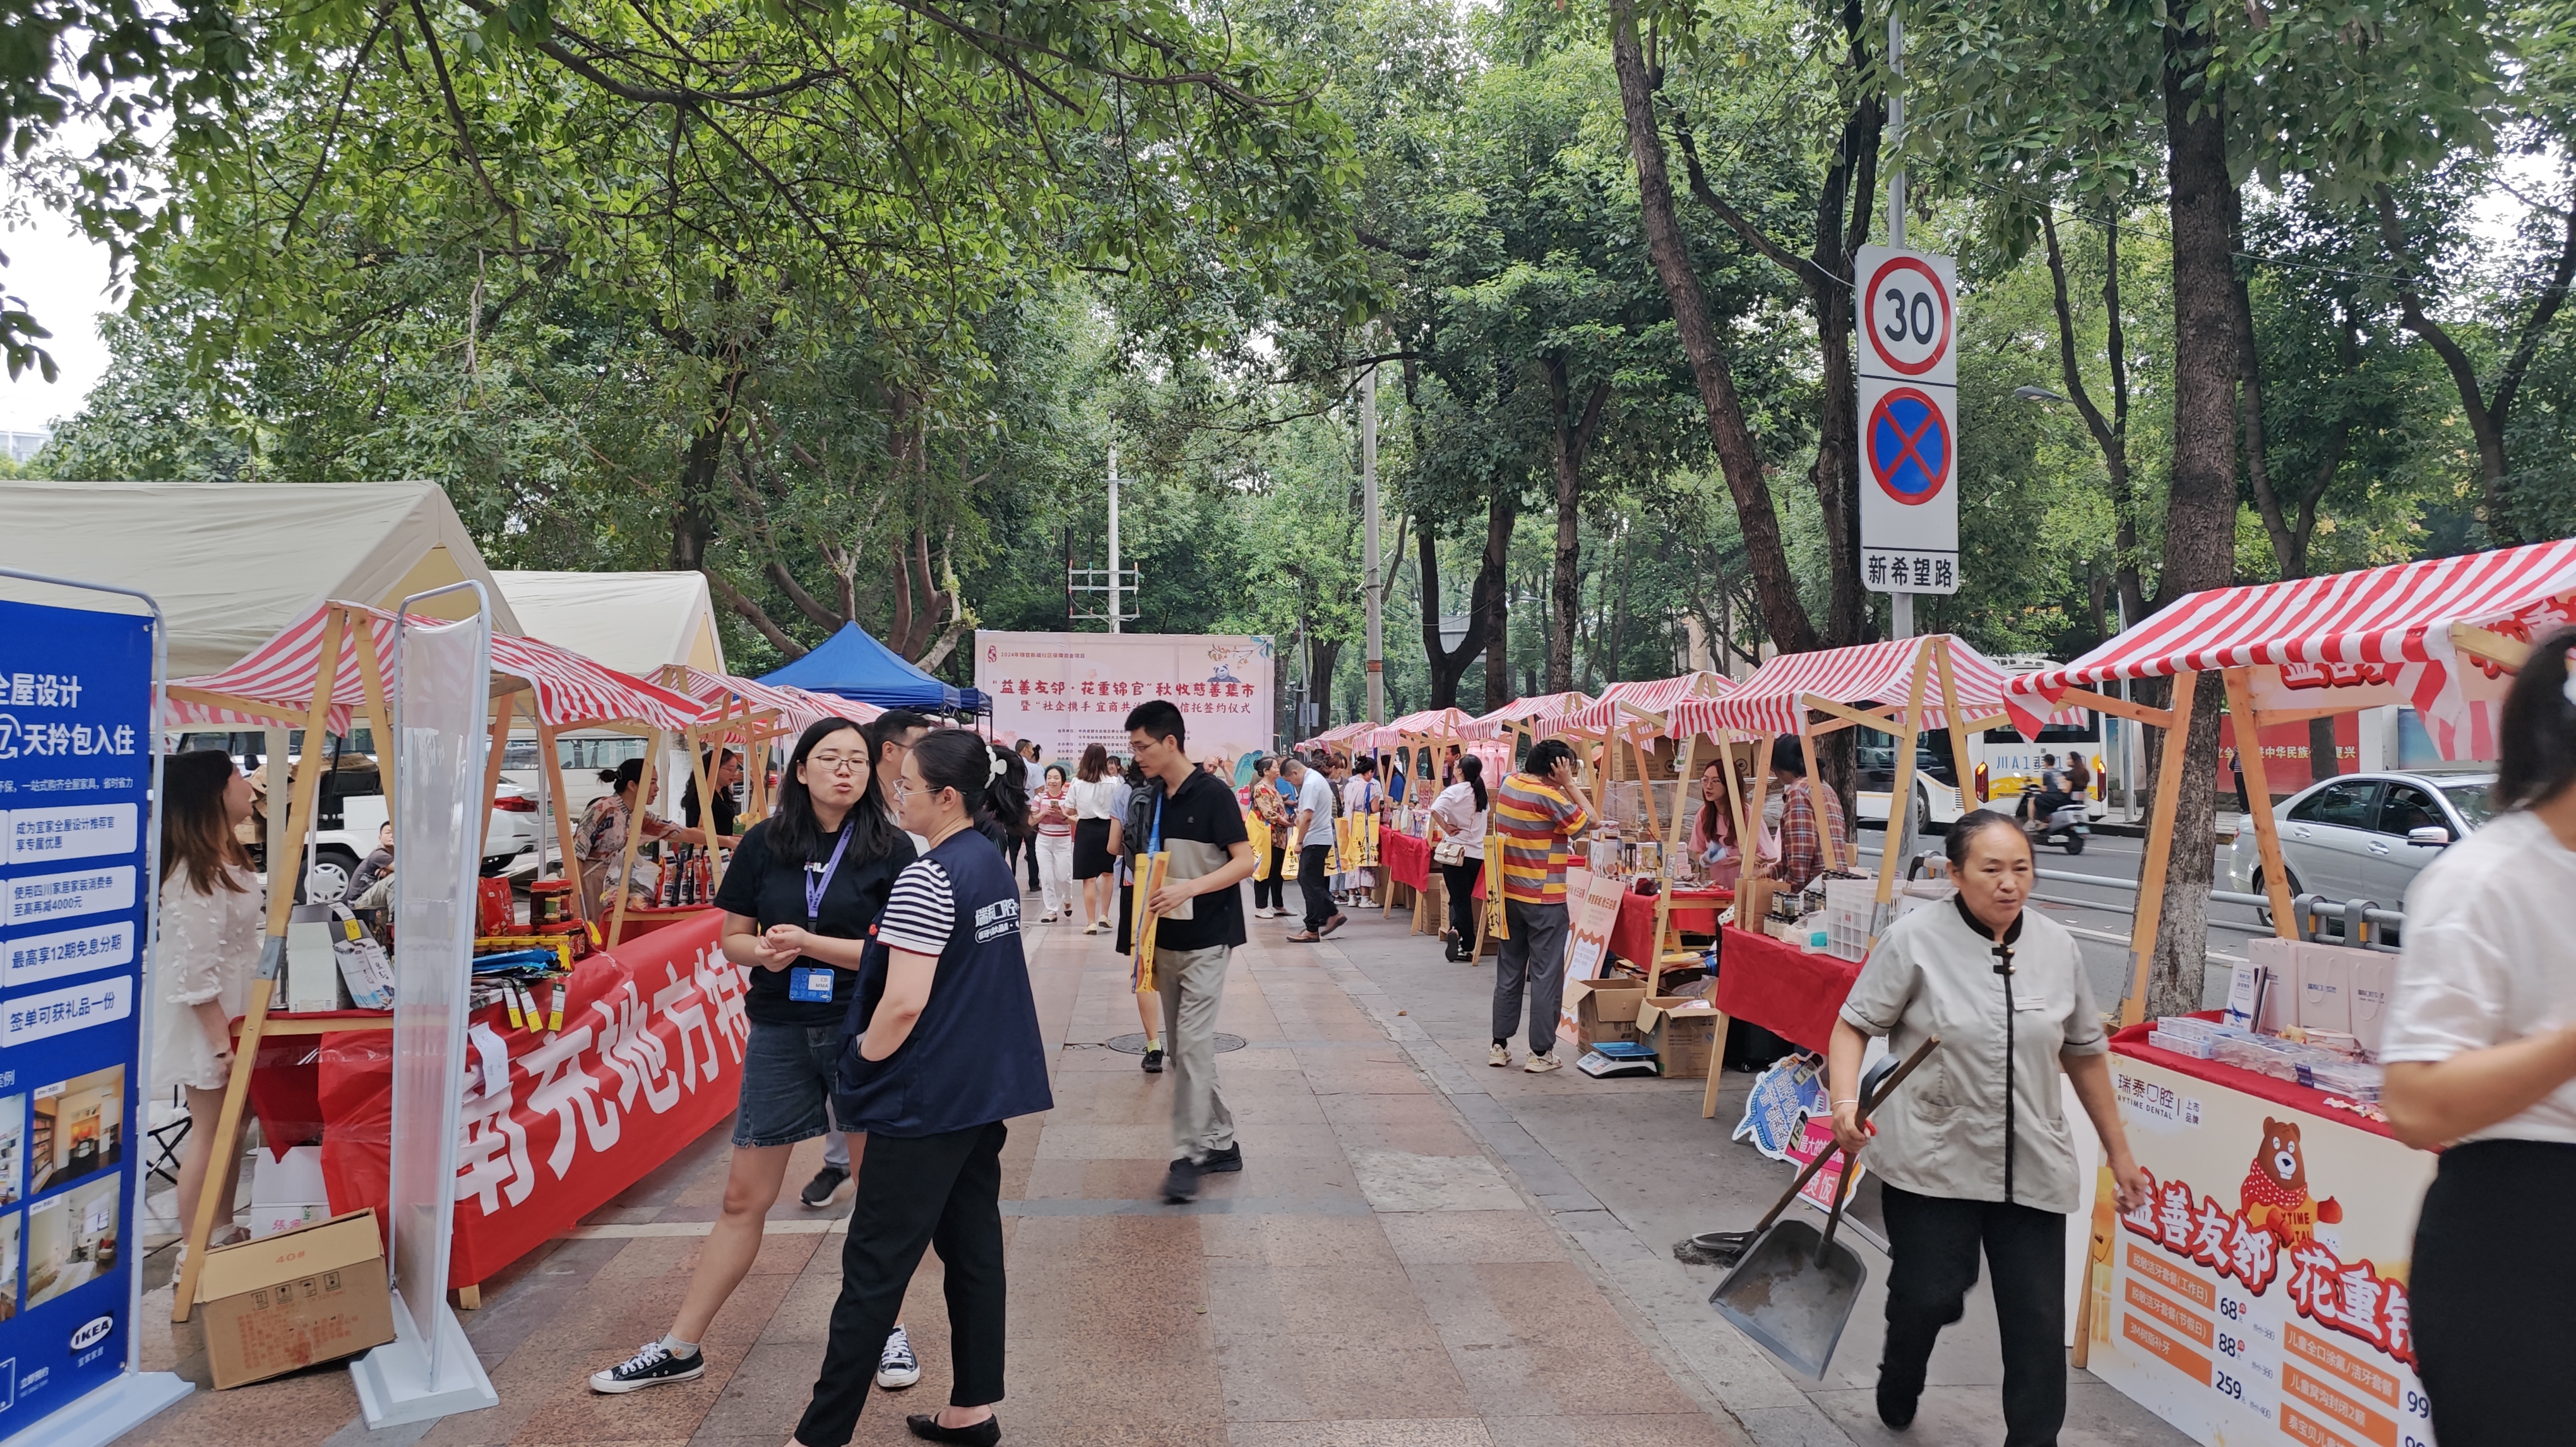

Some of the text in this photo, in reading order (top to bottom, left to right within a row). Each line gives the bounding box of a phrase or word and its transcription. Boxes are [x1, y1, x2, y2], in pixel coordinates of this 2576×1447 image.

[1884, 288, 1935, 345] 30
[1868, 554, 1953, 588] 新希望路
[16, 836, 63, 852] 享专属优惠
[14, 896, 83, 917] 至高再减4000元
[11, 934, 122, 969] 最高享12期免息分期
[10, 991, 115, 1033] 签单可获礼品一份
[455, 941, 751, 1217] 南充地方特
[2118, 1073, 2174, 1109] 瑞泰口腔
[2146, 1104, 2173, 1120] DENTAL
[2185, 1112, 2199, 1126] 品牌
[2186, 1099, 2200, 1112] 上市
[275, 1251, 306, 1263] 40#
[2220, 1297, 2238, 1321] 68
[75, 1319, 109, 1346] IKEA
[2219, 1332, 2236, 1357] 88
[2287, 1330, 2393, 1398] 儿童全口涂氟/洁牙套餐
[2216, 1370, 2241, 1400] 259
[2290, 1373, 2366, 1428] 儿童窝沟封闭2颗
[2407, 1390, 2430, 1419] 99
